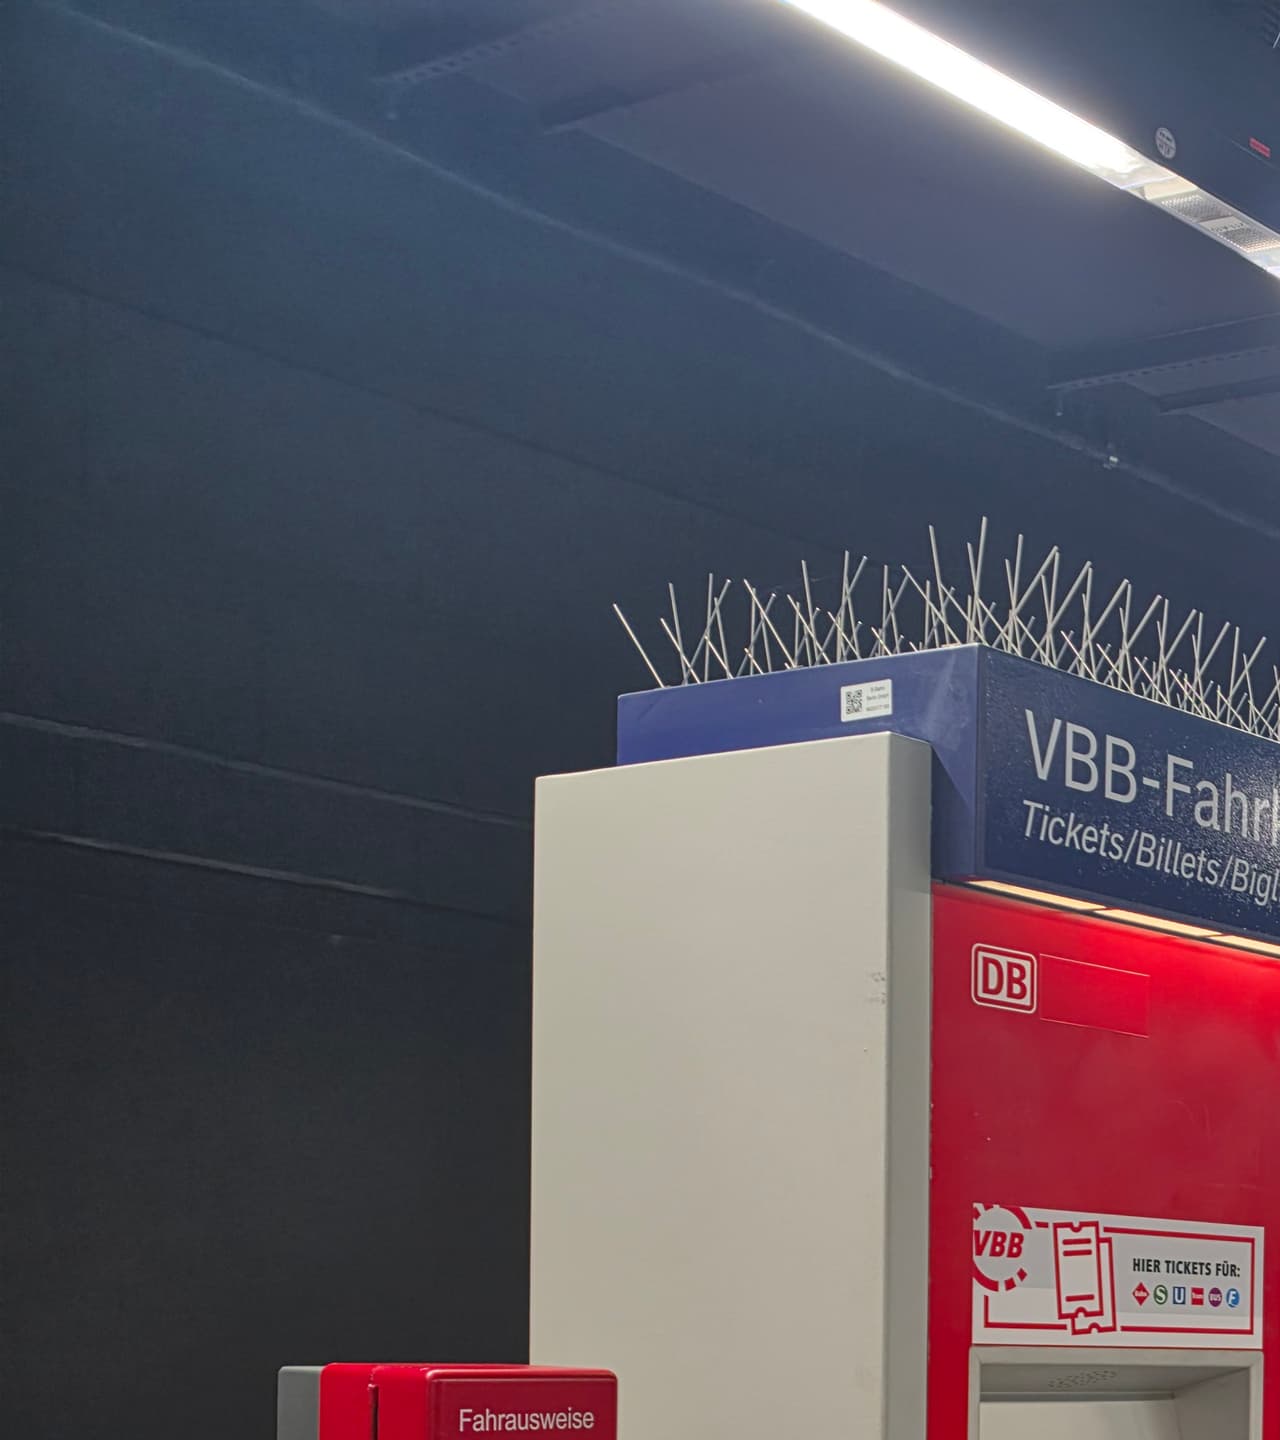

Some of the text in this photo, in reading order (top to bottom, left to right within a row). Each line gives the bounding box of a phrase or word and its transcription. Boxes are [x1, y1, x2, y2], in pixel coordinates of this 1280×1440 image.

[979, 953, 1030, 1003] DB
[973, 1230, 1025, 1258] VBB
[1132, 1258, 1241, 1278] HIER TICKETS FÜR:
[1174, 1287, 1185, 1304] U
[459, 1407, 595, 1432] Fahrausweise
